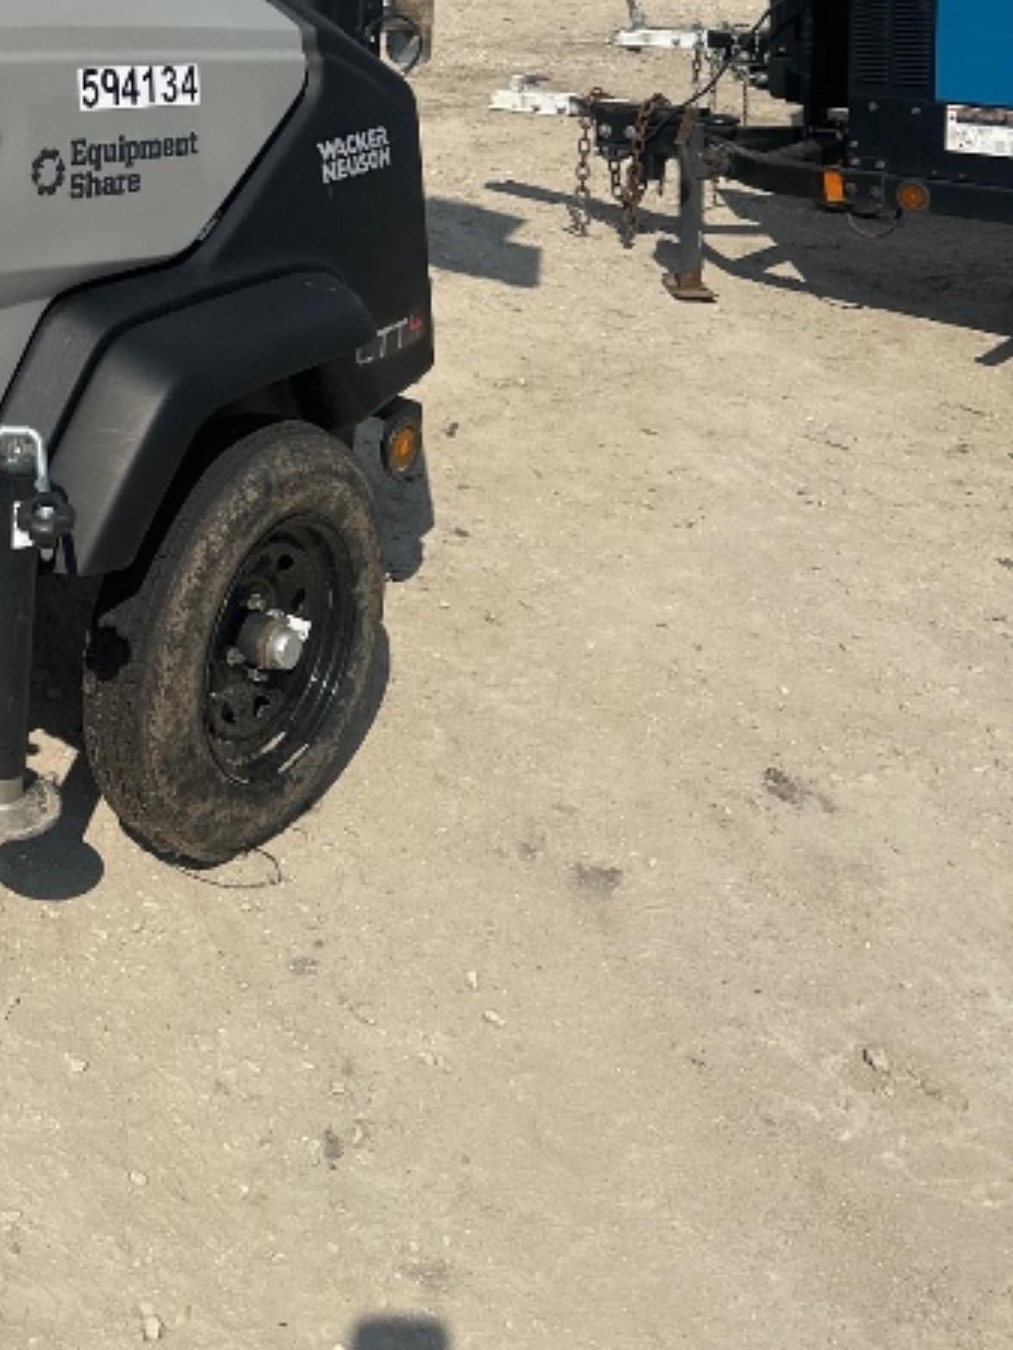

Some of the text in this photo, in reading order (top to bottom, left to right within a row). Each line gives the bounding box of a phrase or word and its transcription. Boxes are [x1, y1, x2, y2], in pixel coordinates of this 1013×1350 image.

[82, 65, 198, 108] 594134
[70, 132, 199, 171] Equipment
[317, 125, 390, 161] WACKER
[322, 146, 392, 184] NEUSON
[70, 171, 142, 200] Share
